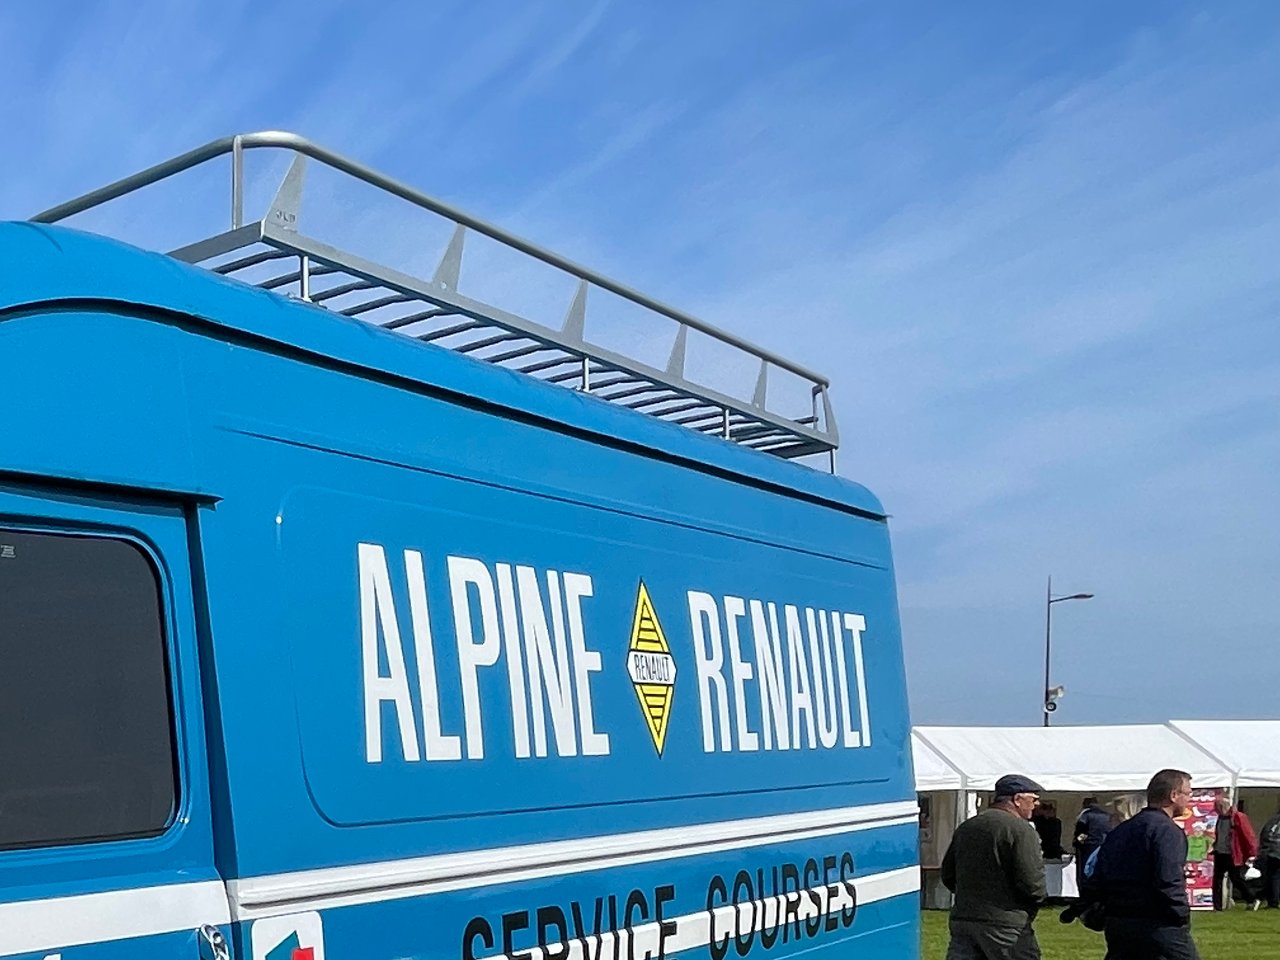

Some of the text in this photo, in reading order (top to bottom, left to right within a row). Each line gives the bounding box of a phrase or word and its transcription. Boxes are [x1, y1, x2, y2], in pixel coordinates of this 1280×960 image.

[357, 543, 872, 763] ALPINE RENAULT
[633, 653, 671, 682] RENAULT
